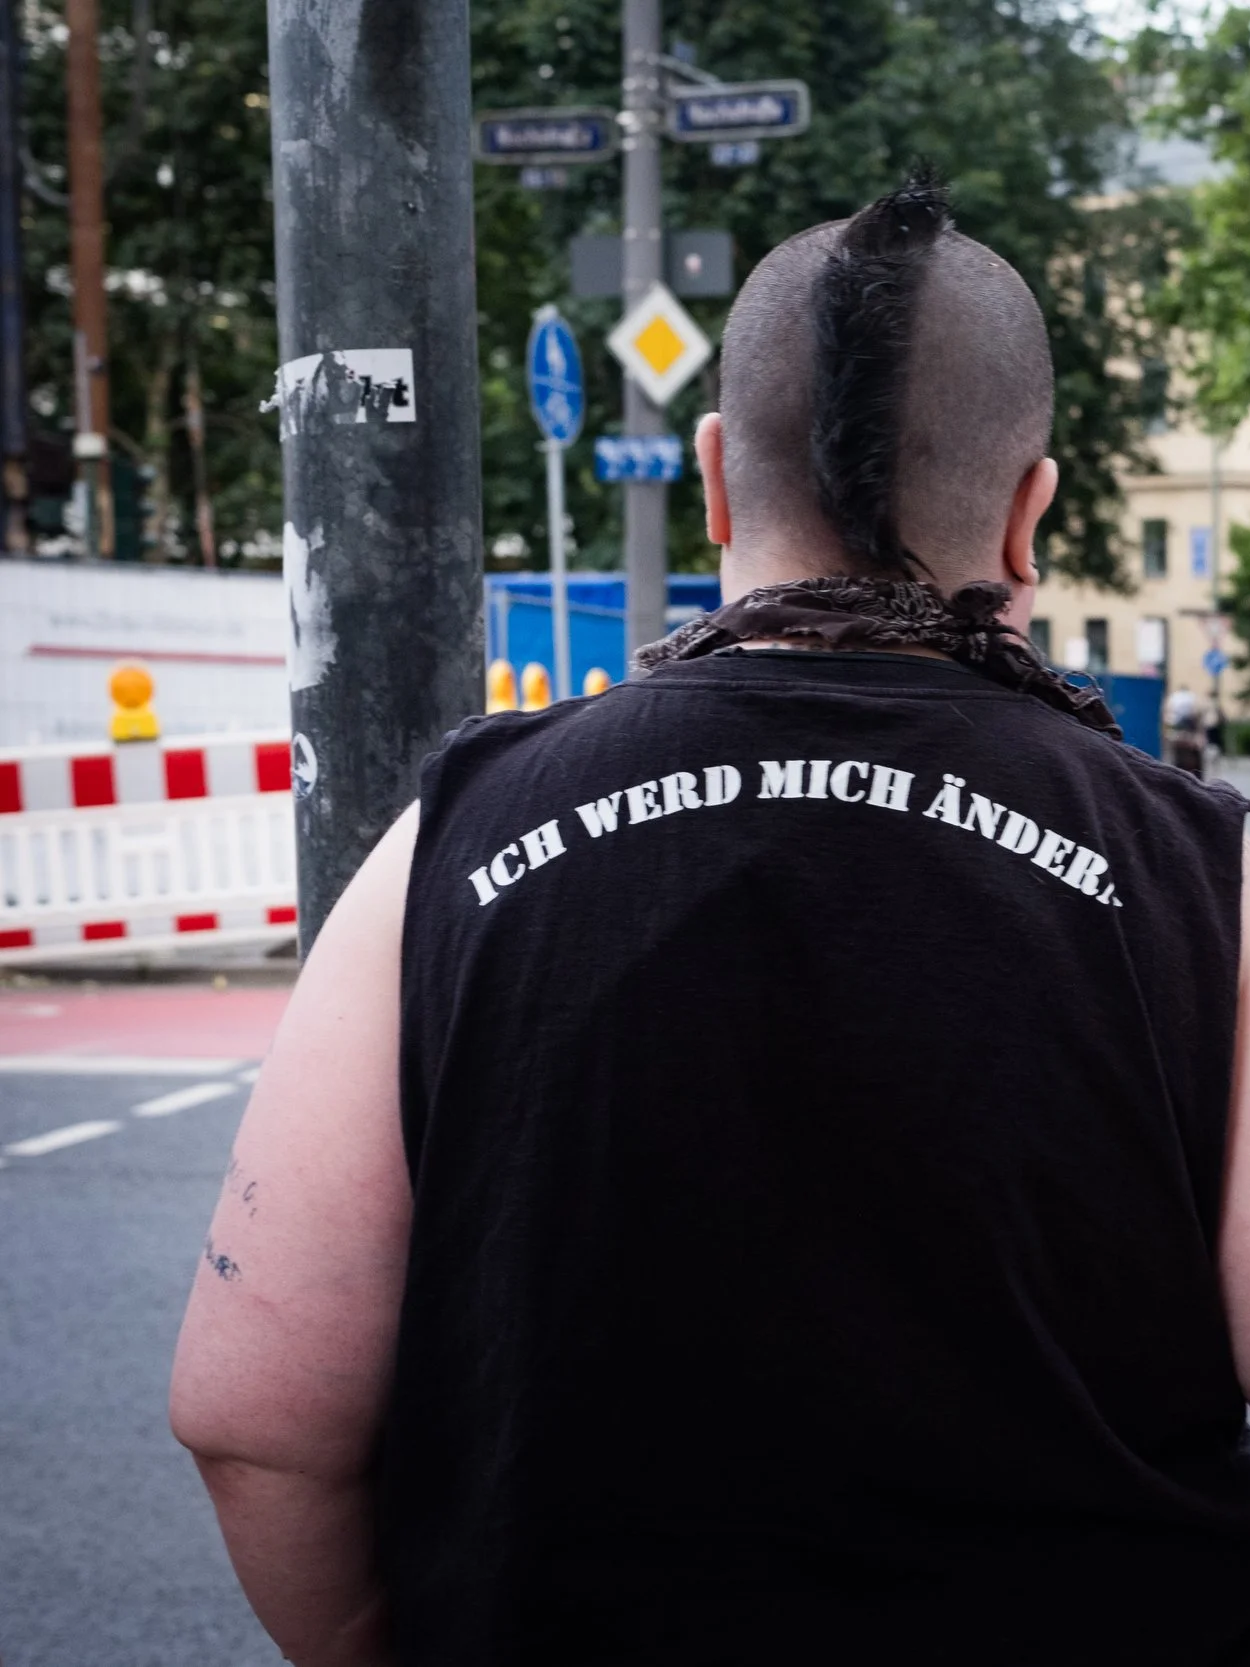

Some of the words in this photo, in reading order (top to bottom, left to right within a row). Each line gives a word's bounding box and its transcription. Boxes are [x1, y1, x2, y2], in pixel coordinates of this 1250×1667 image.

[467, 819, 567, 906] ICH
[574, 764, 742, 838] WERD
[757, 759, 916, 812] MICH
